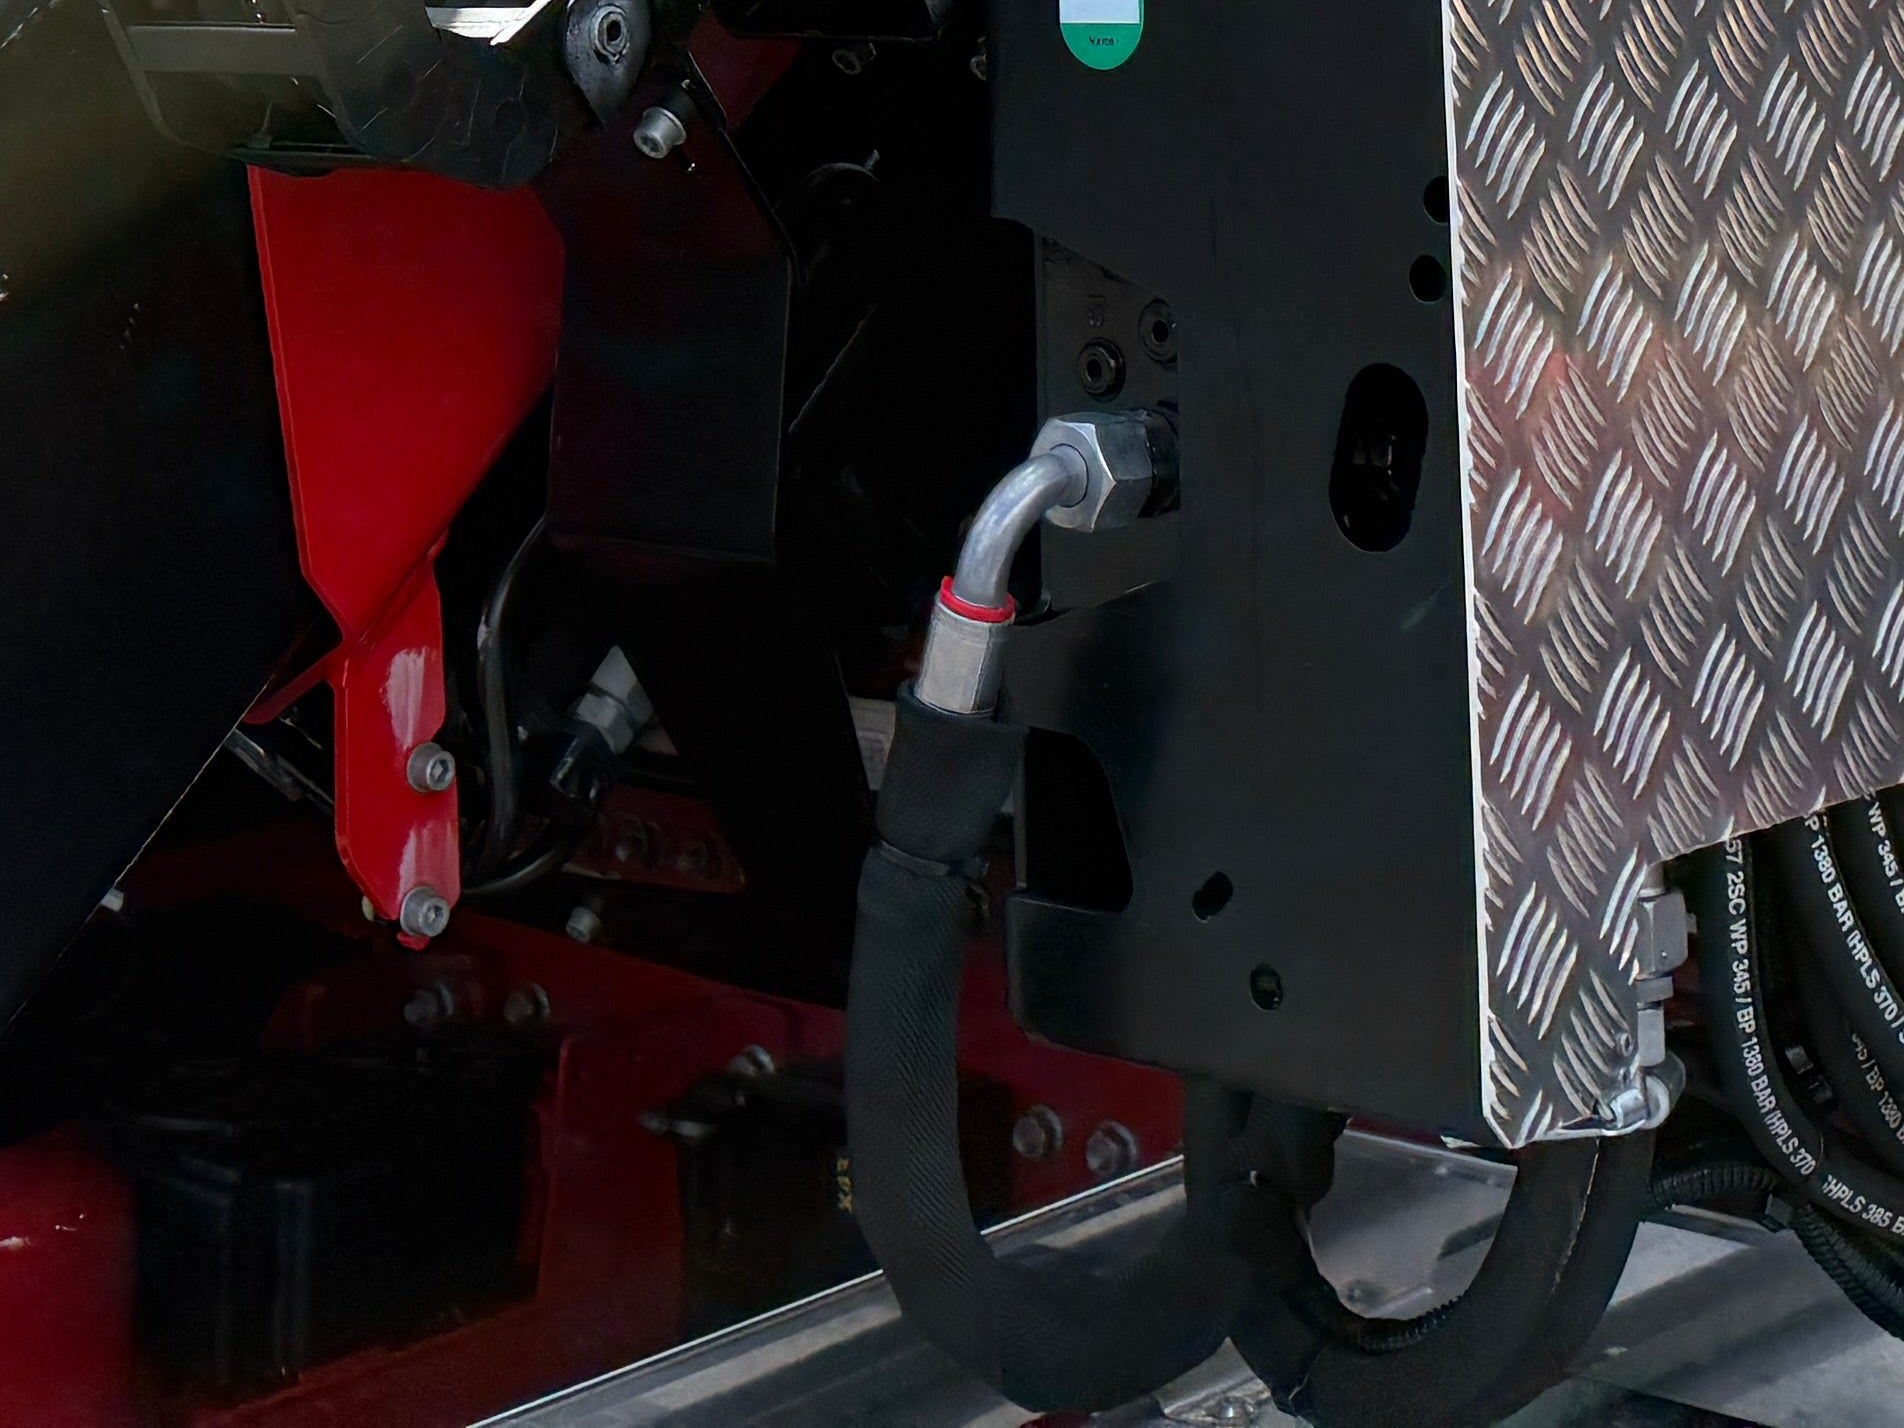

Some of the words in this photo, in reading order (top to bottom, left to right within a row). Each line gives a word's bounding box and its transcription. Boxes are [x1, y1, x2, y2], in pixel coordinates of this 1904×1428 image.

[1877, 840, 1901, 878] 345
[1726, 870, 1746, 916] 2SC
[1728, 918, 1748, 956] WP
[1810, 836, 1836, 884] 1380
[1826, 885, 1855, 932] BAR
[1846, 930, 1881, 990] (HPLS
[1873, 986, 1898, 1021] 370
[1731, 958, 1752, 995] 345
[1737, 1007, 1756, 1034] BP
[1741, 1036, 1764, 1078] 1380
[1751, 1076, 1776, 1114] BAR
[1865, 1066, 1886, 1092] BP
[1877, 1091, 1902, 1130] 1380
[1764, 1110, 1798, 1156] (HPLS
[1790, 1148, 1817, 1176] 370
[1861, 1204, 1894, 1229] 385
